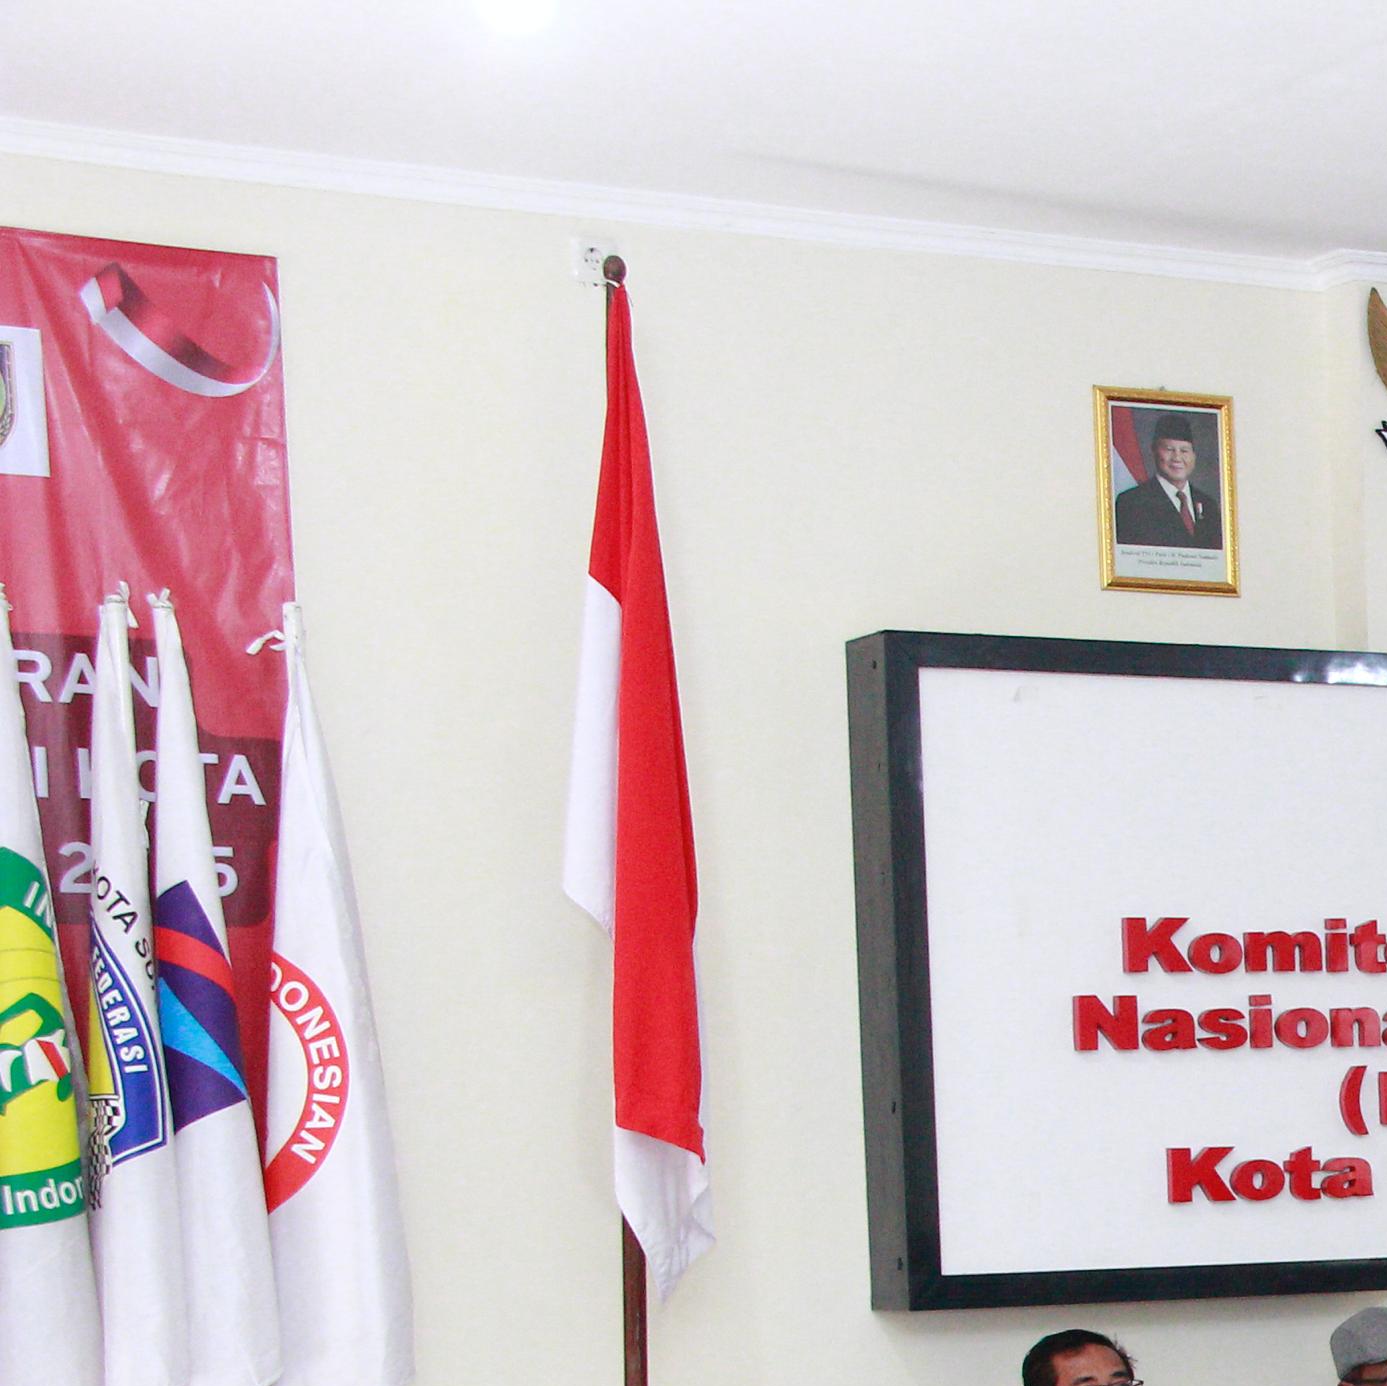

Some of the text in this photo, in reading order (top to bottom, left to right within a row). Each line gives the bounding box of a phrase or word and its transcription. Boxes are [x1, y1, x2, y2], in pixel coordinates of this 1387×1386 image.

[76, 746, 267, 807] OA
[58, 841, 239, 898] 25
[94, 867, 139, 934] OTA
[1166, 1146, 1374, 1204] Kota
